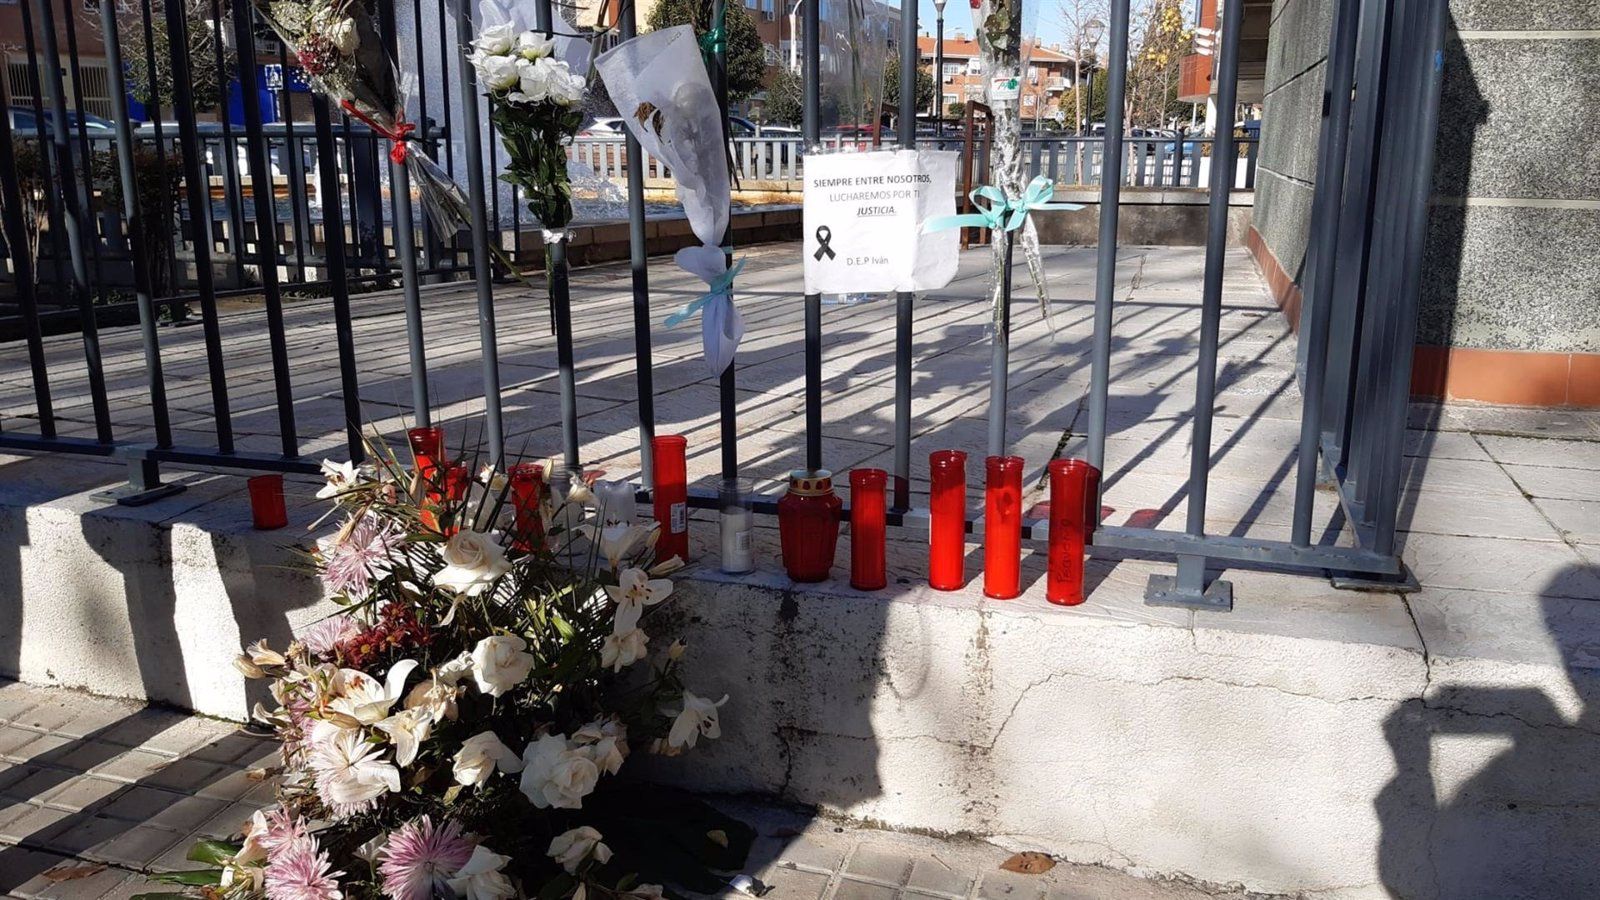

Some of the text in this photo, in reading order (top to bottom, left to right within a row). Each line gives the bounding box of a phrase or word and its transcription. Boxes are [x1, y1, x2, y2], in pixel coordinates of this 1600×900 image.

[813, 174, 932, 188] SIEMPRE ENTRE NOSOTROS,
[829, 190, 891, 203] LUCHAREMOS
[893, 189, 911, 200] POR
[872, 256, 889, 265] Iván
